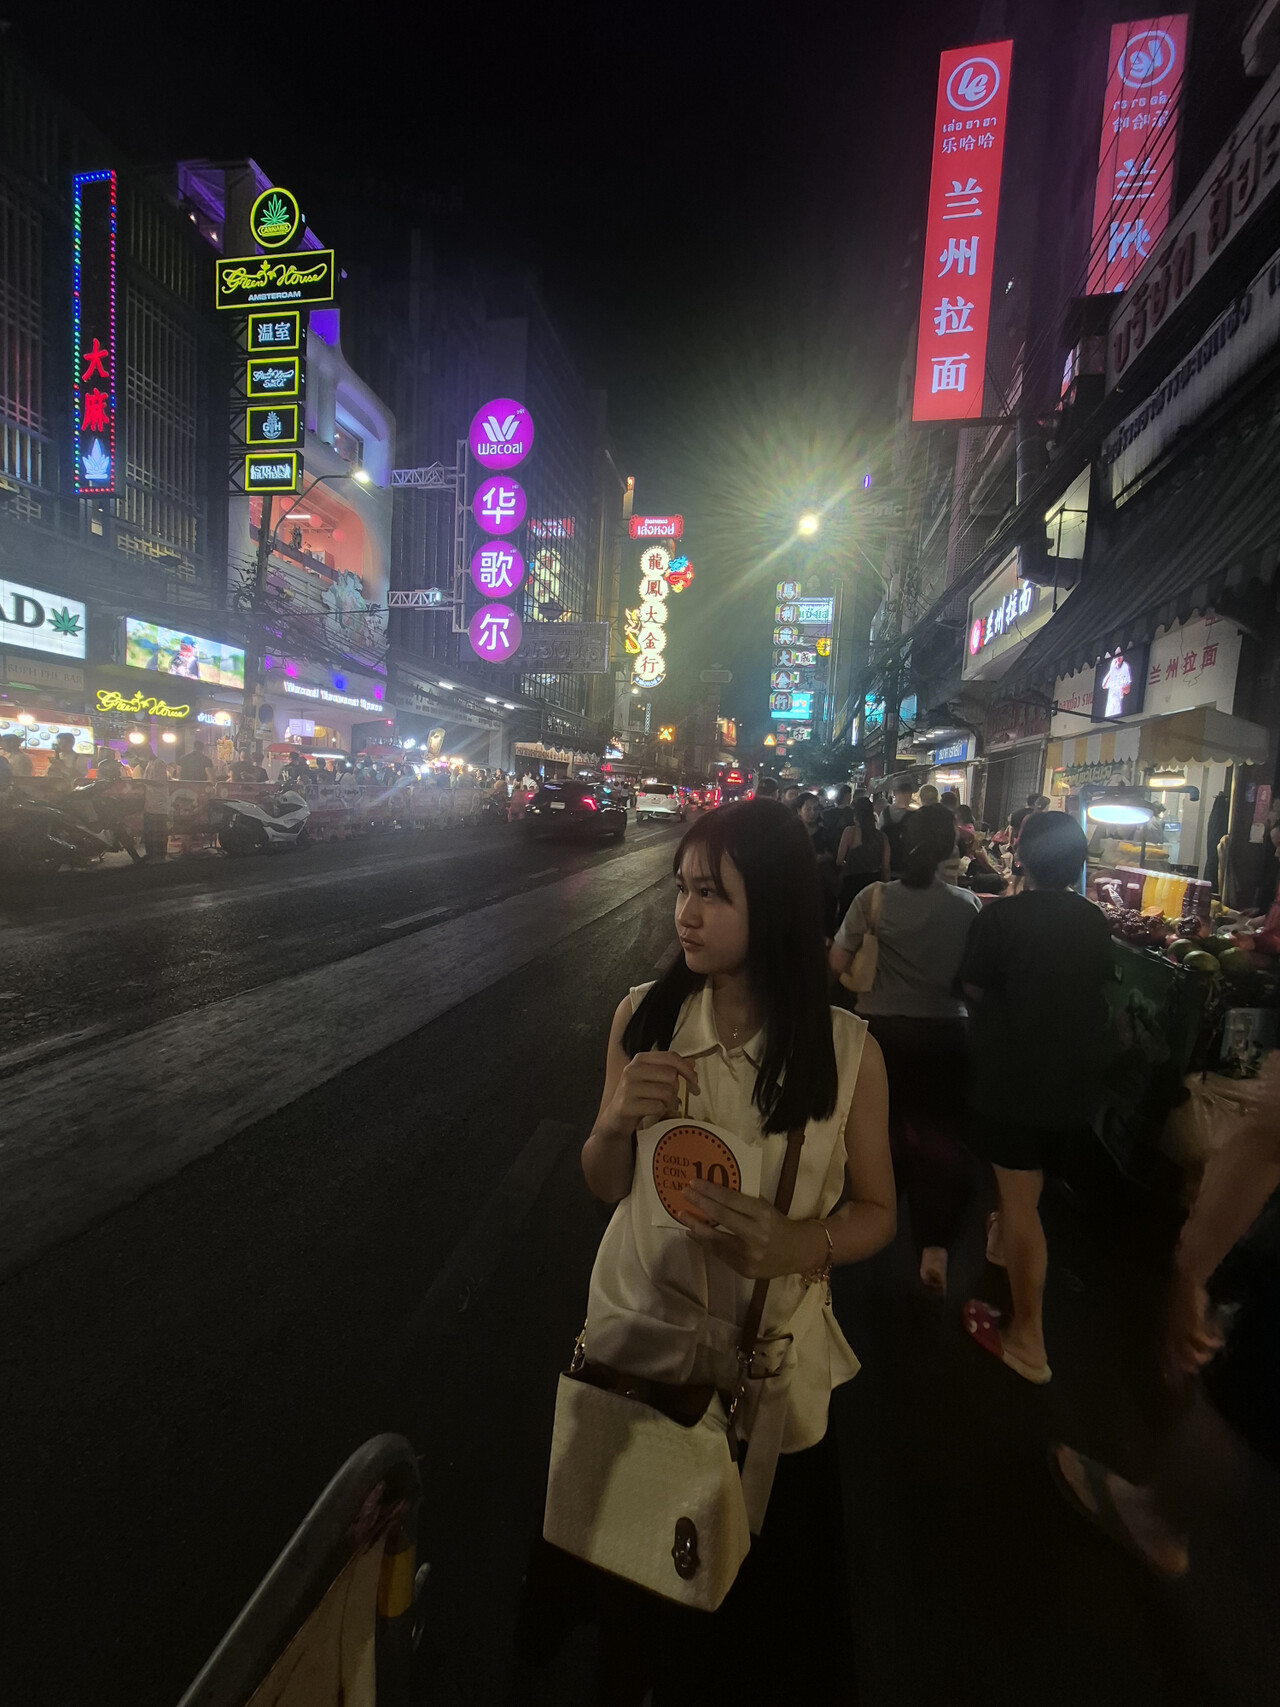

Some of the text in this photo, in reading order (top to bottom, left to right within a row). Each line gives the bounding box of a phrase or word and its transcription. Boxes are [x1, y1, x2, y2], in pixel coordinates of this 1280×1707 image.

[942, 132, 995, 154] 乐哈哈
[260, 224, 289, 234] CANNABIS
[221, 263, 328, 294] Green House
[931, 177, 984, 394] 兰州拉面
[248, 290, 302, 301] AMSTERDAM
[257, 321, 291, 343] 温室
[81, 337, 110, 432] 大麻
[477, 441, 523, 456] Wacoal
[478, 486, 517, 651] 华歌尔
[641, 552, 664, 674] 龍鳳大金行
[1148, 643, 1219, 685] 兰州拉面
[96, 690, 190, 719] Green House
[662, 1154, 690, 1167] GOLD
[663, 1166, 687, 1178] COIN
